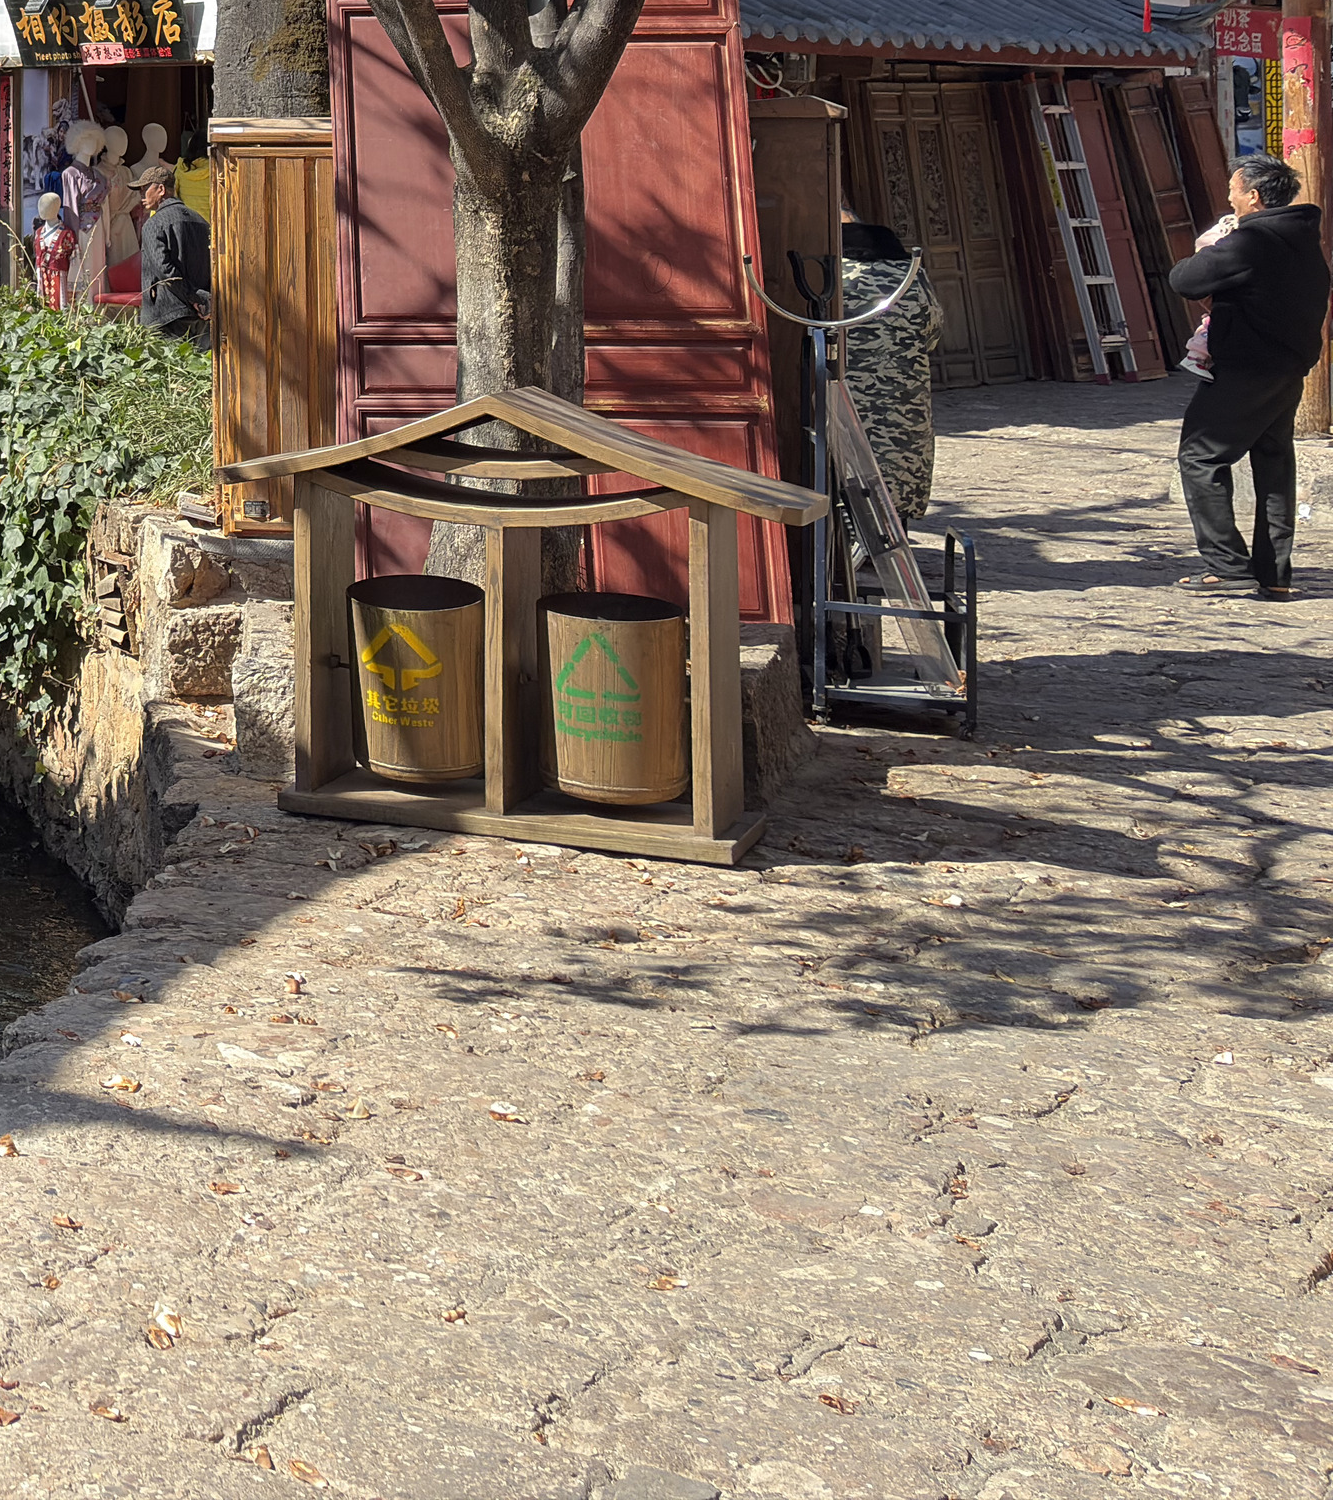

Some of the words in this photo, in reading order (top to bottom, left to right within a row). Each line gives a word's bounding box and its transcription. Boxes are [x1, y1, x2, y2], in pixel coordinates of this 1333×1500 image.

[35, 51, 52, 61] Meet
[52, 51, 72, 62] photo
[366, 689, 440, 715] 其它垃圾
